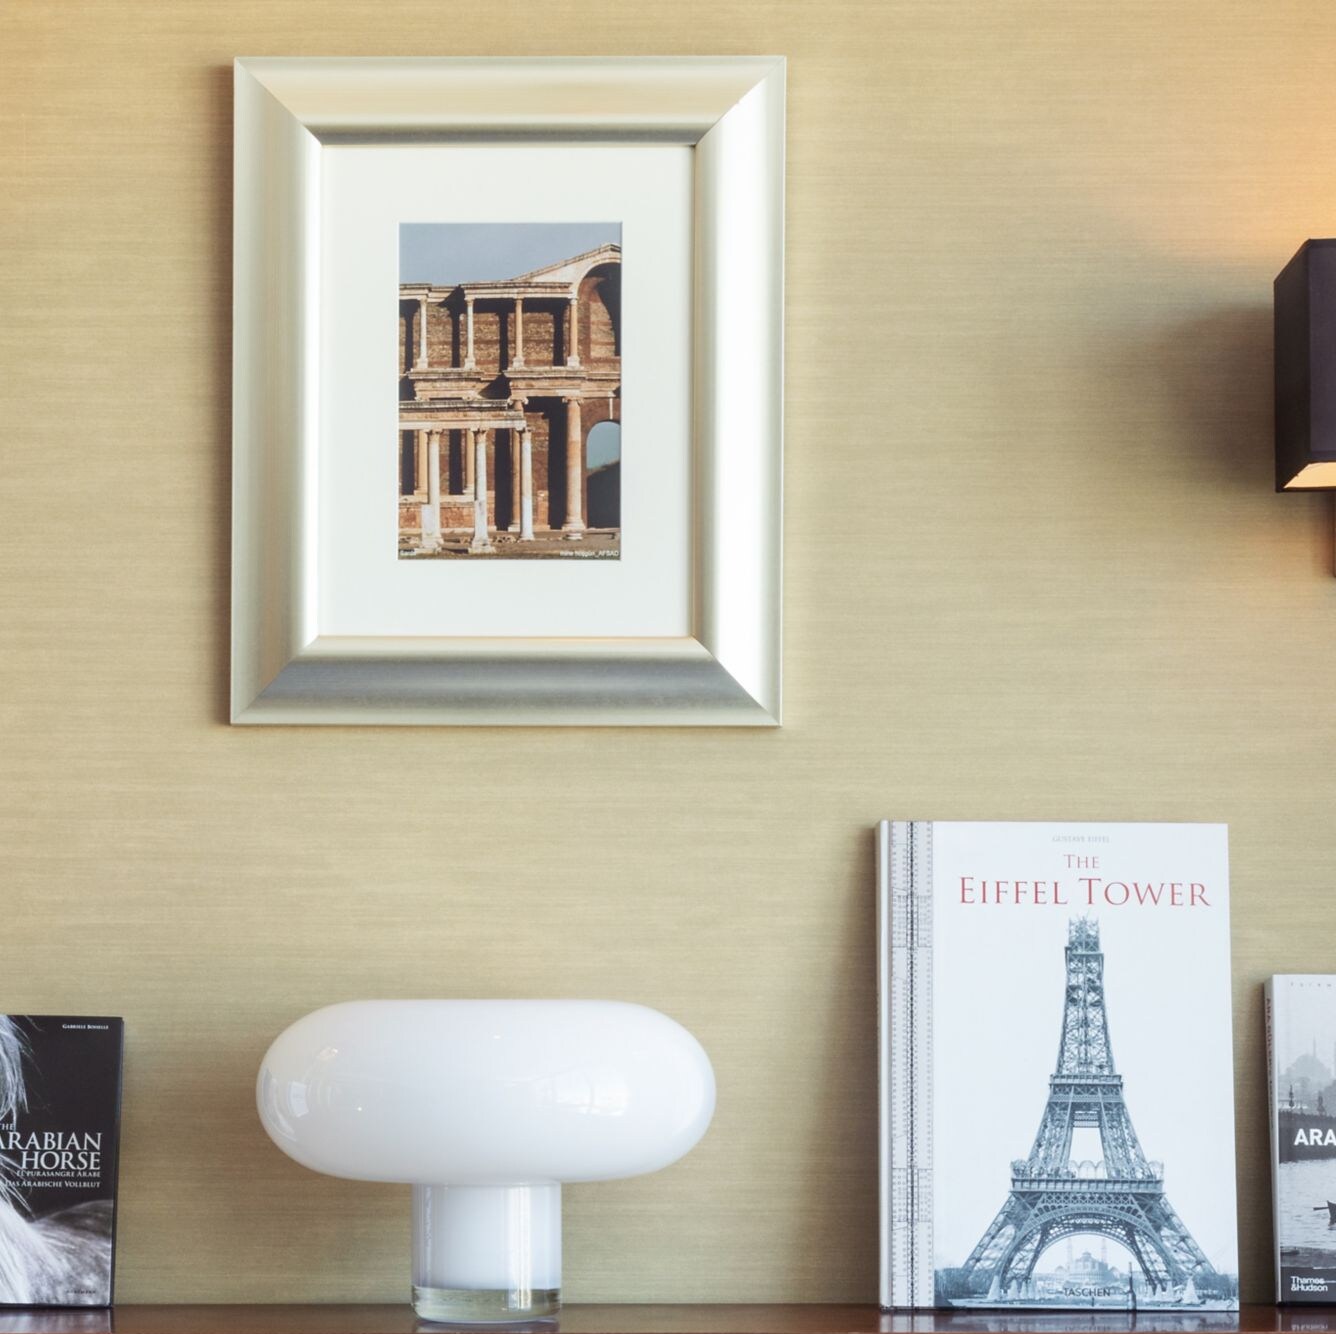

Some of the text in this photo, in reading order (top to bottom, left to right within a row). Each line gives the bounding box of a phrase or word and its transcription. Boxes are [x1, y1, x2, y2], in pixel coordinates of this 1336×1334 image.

[1063, 854, 1100, 869] THE
[960, 877, 1211, 906] EIFFEL TOWER
[1294, 1128, 1336, 1146] ARA
[22, 1151, 101, 1170] HORSE
[1291, 1276, 1326, 1285] Thames
[1291, 1284, 1328, 1292] &Hudson
[1063, 1287, 1111, 1297] TASCHEN
